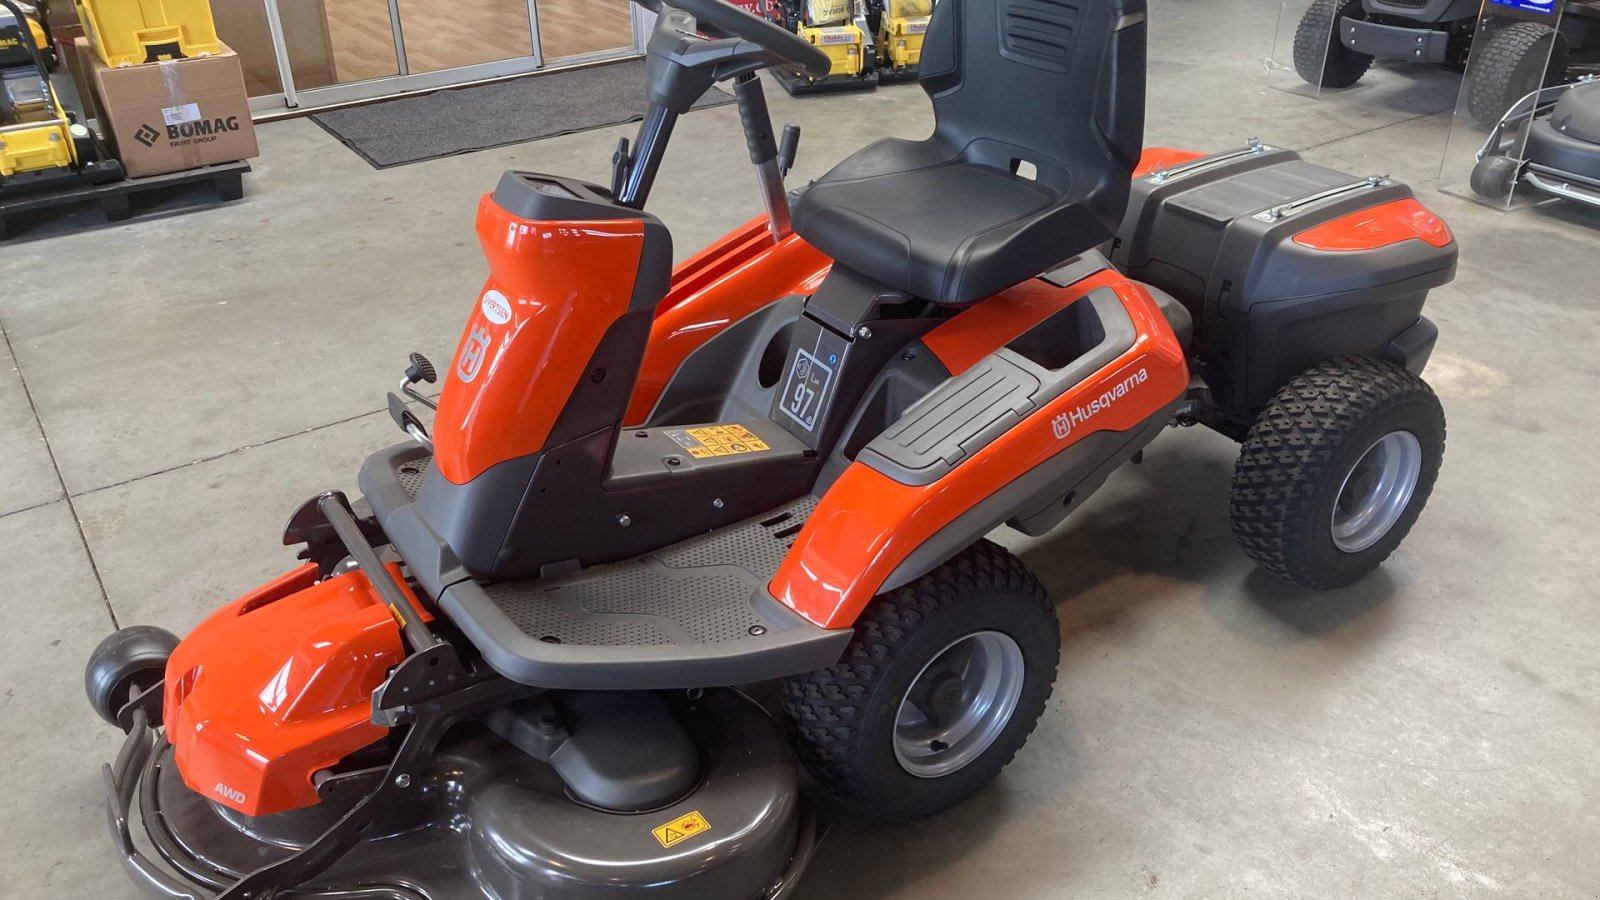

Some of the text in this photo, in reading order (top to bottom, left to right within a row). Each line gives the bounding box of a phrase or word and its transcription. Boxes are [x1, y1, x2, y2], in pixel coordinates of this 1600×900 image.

[166, 116, 240, 140] BOMAG
[193, 136, 217, 145] GROUP
[791, 383, 815, 418] 97
[1069, 368, 1148, 428] Husqvarna
[214, 782, 246, 805] AWD
